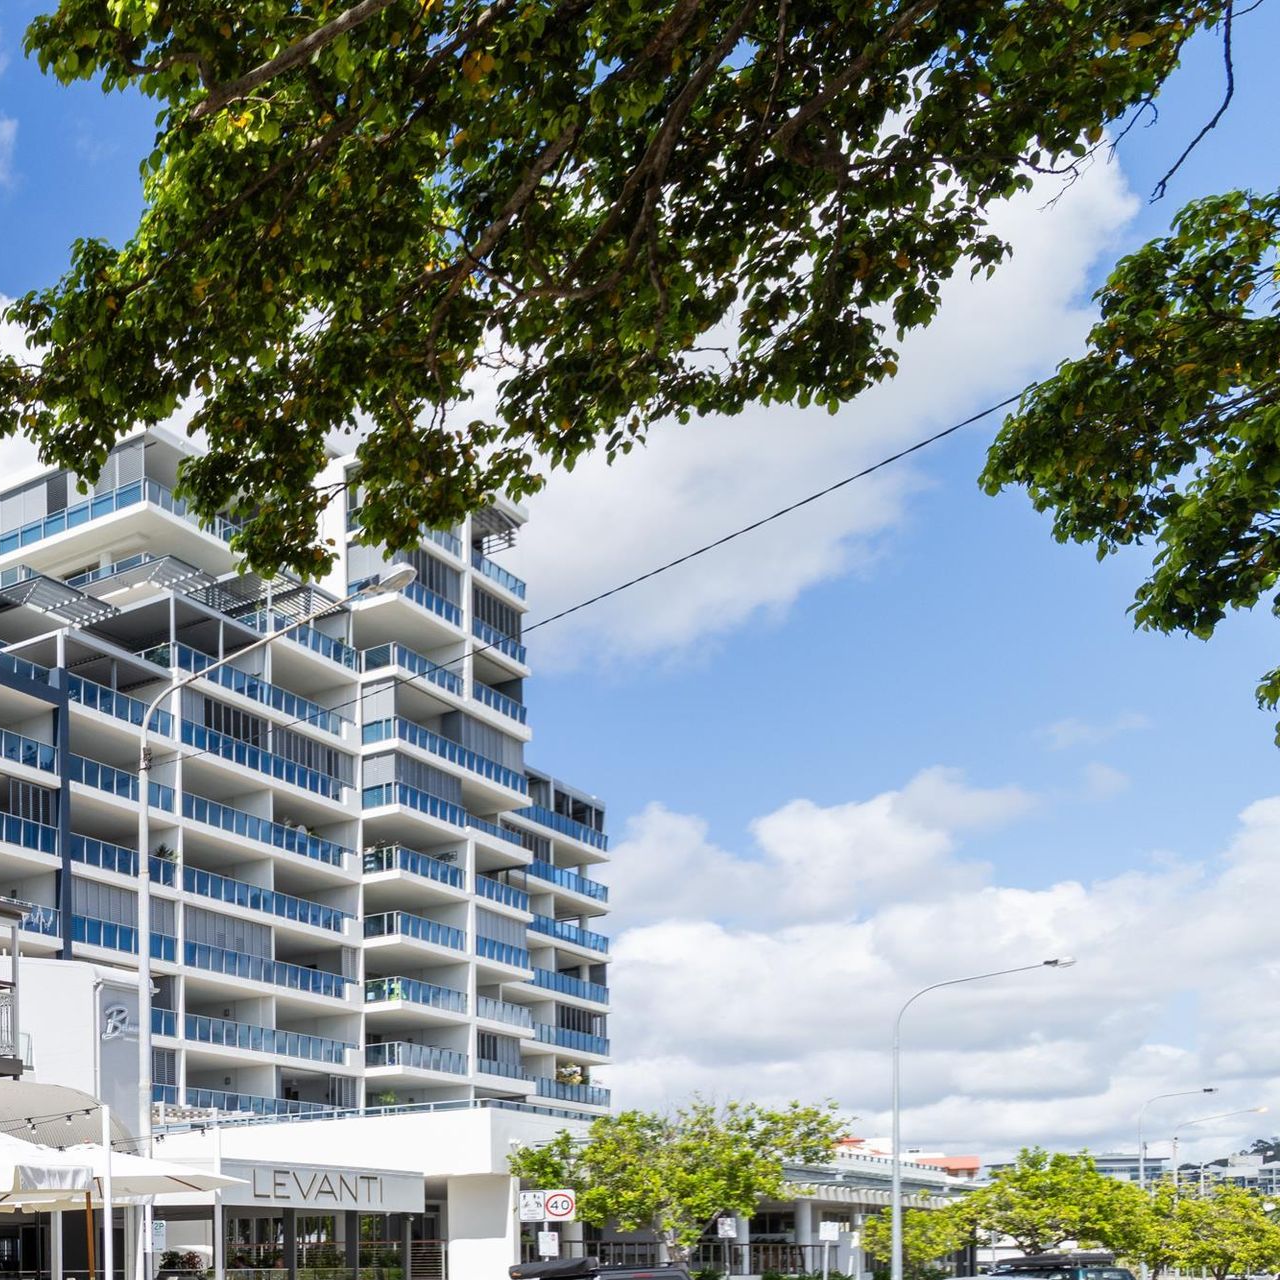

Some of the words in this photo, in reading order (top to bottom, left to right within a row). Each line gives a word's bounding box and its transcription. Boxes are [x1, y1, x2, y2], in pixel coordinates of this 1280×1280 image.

[253, 1168, 383, 1203] LEVANTI
[550, 1200, 569, 1210] 40
[154, 1222, 165, 1231] 2P
